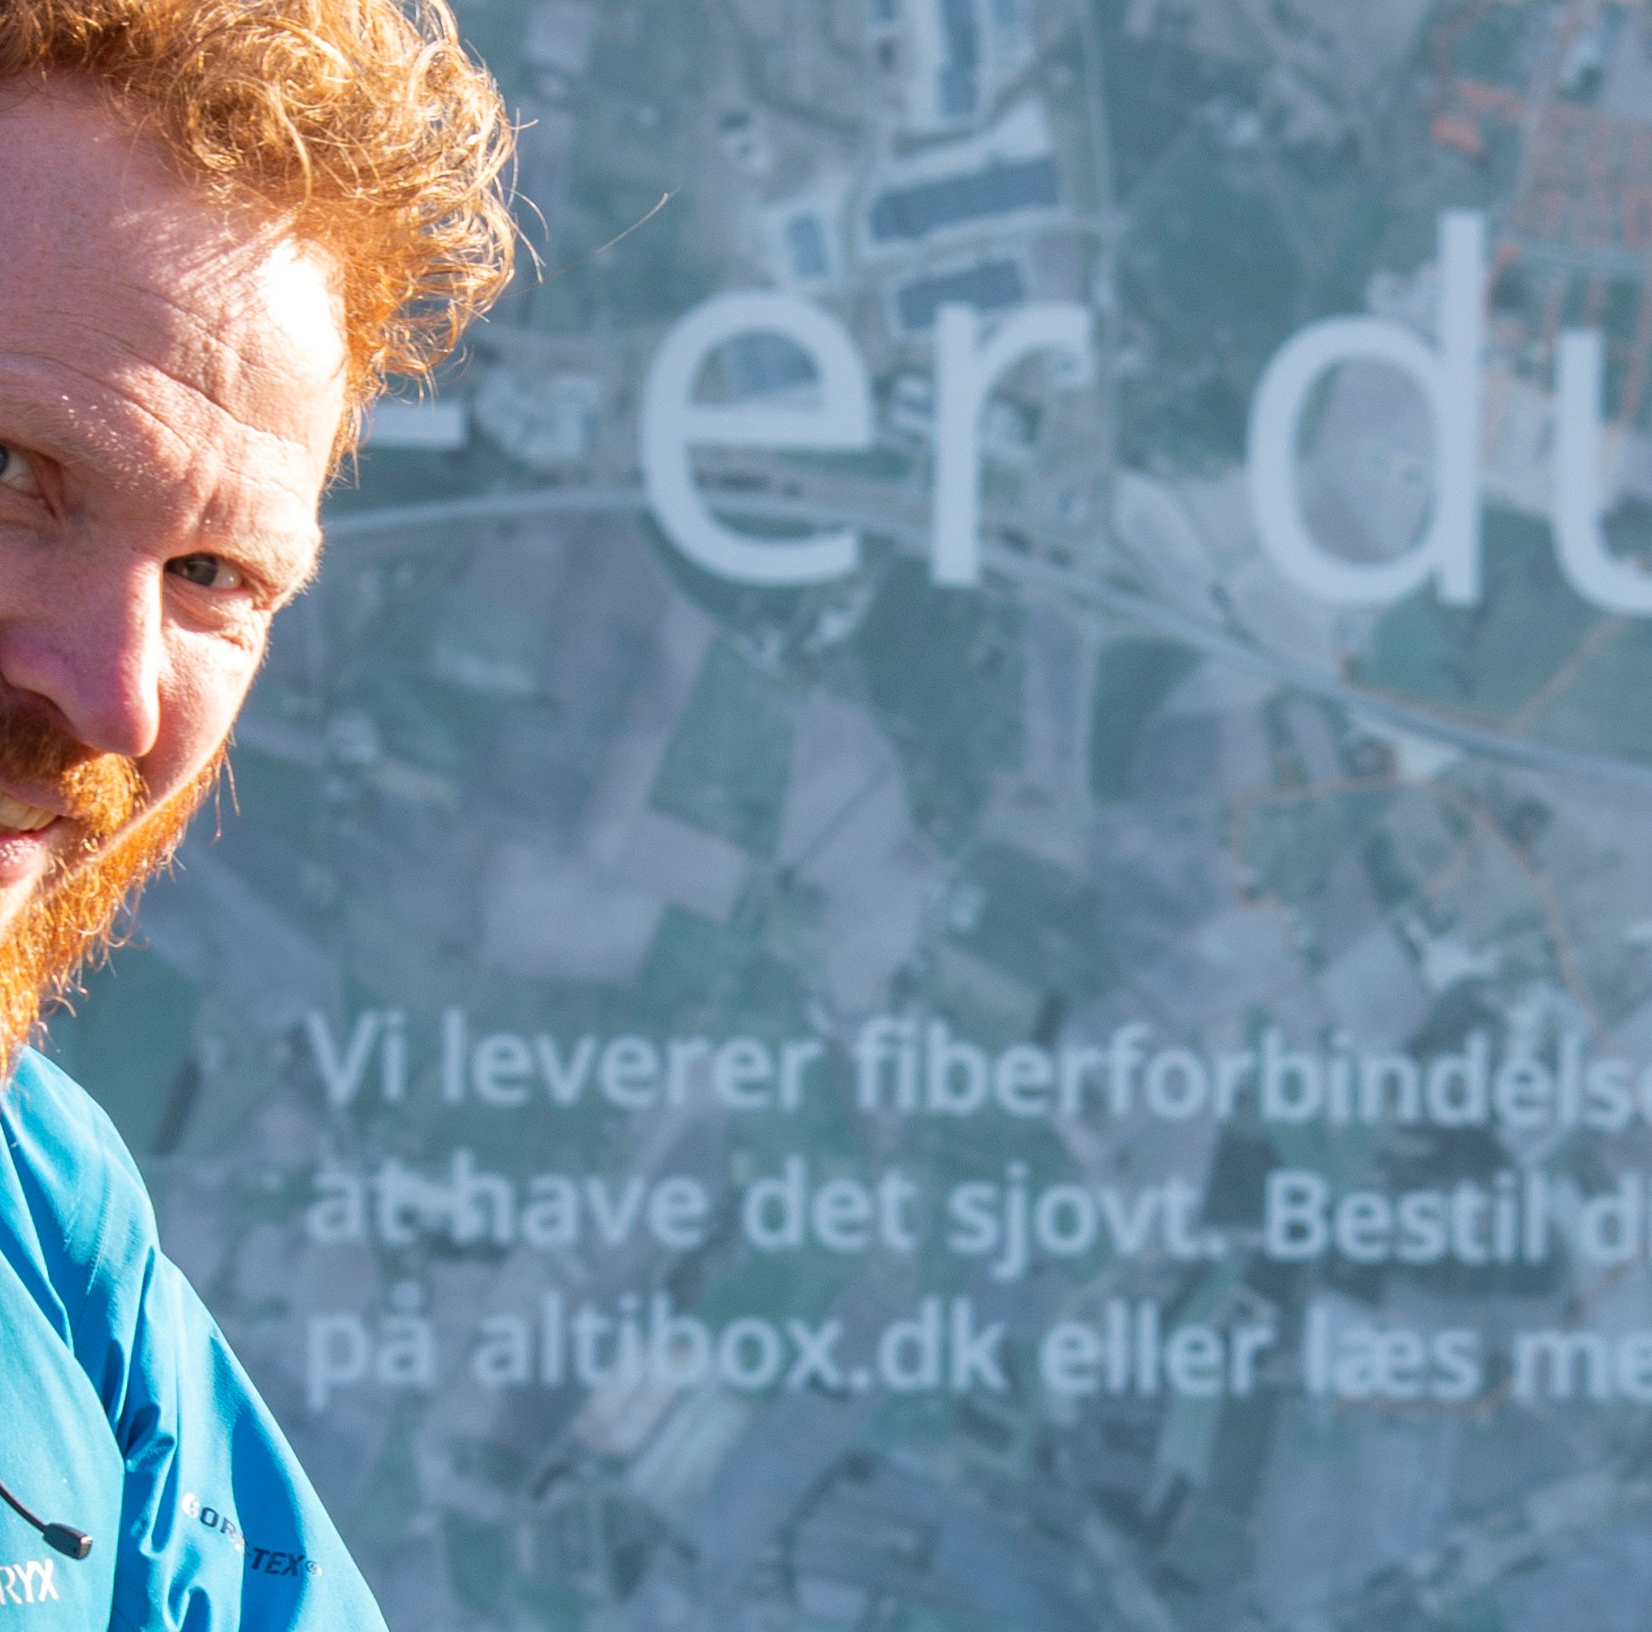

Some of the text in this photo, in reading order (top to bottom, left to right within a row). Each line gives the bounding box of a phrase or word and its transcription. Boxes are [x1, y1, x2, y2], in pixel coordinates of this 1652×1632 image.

[640, 290, 1091, 588] er
[304, 1010, 409, 1108] Vi
[442, 1010, 822, 1112] leverer
[310, 1158, 432, 1248] at
[454, 1150, 708, 1249] have
[744, 1154, 917, 1253] det
[951, 1162, 1228, 1281] sjovt.
[1265, 1169, 1547, 1264] Bestil
[308, 1281, 435, 1405] på
[473, 1292, 1008, 1395] altibox.dk
[1038, 1302, 1275, 1397] eller
[1304, 1306, 1482, 1400] læs
